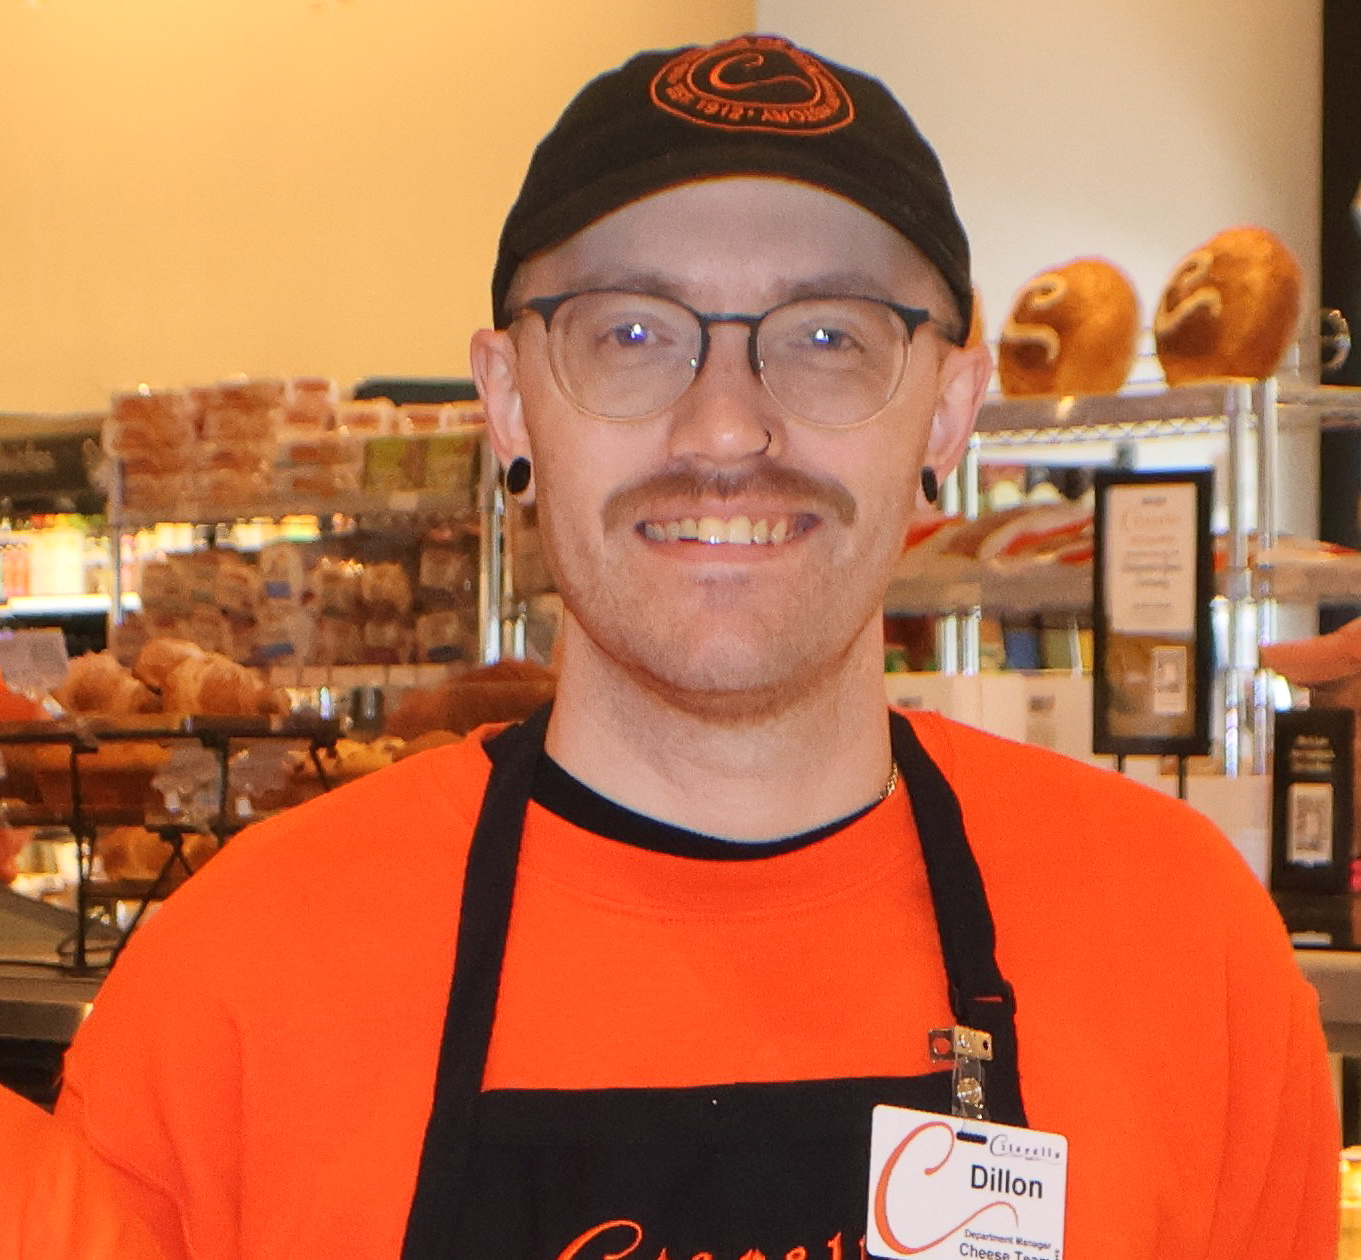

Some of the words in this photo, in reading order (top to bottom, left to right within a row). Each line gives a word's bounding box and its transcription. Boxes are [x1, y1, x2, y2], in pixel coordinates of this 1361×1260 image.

[989, 1133, 1063, 1162] Citarella
[970, 1163, 1044, 1199] Dillon
[964, 1228, 1014, 1245] Department
[1015, 1236, 1052, 1251] Manager
